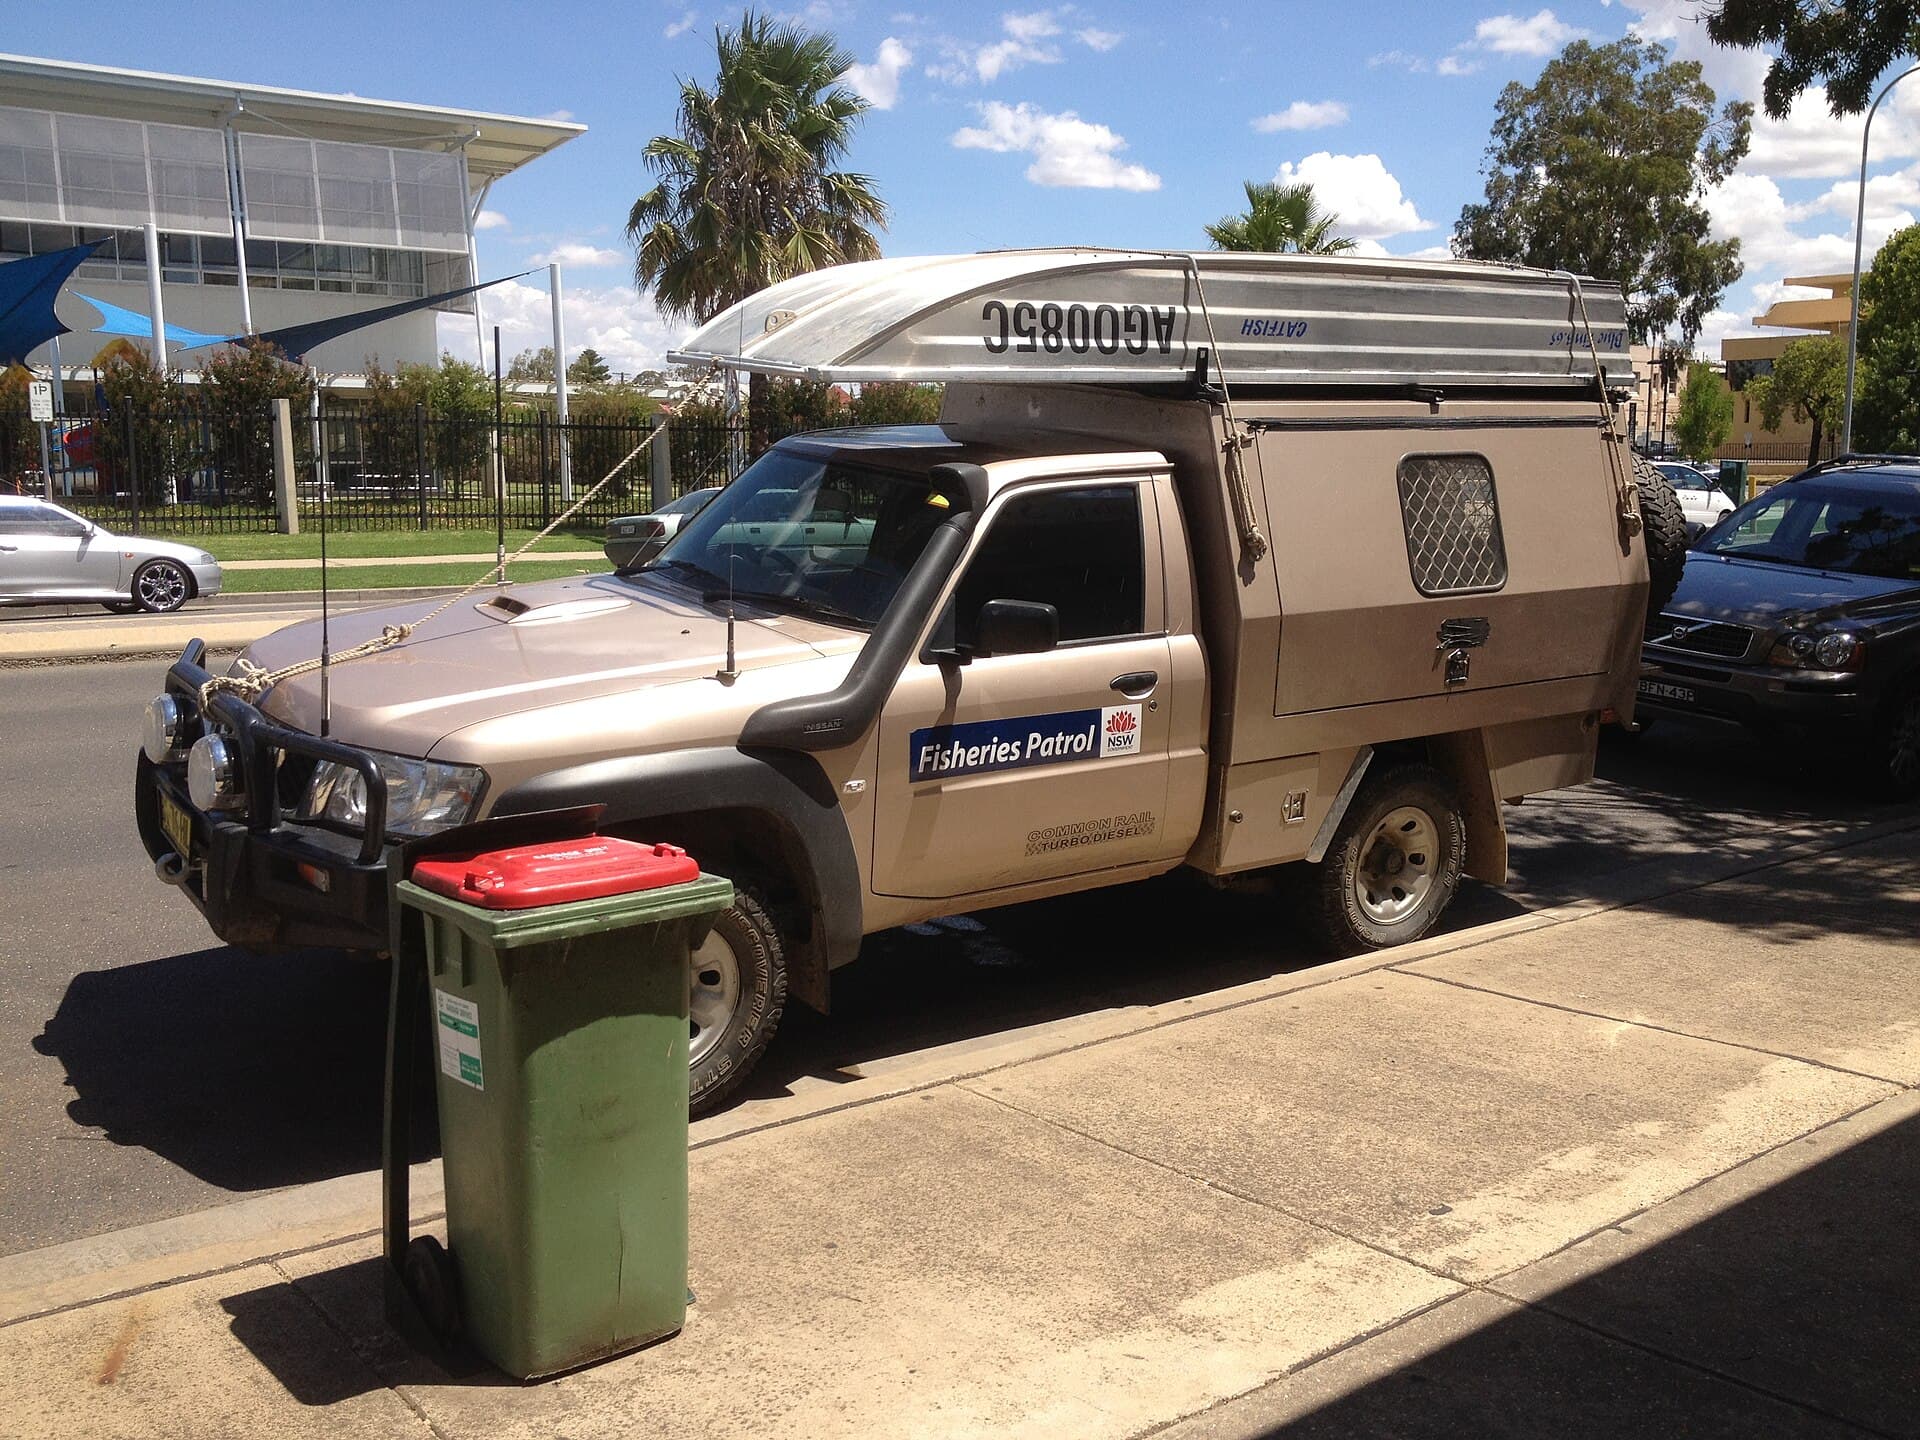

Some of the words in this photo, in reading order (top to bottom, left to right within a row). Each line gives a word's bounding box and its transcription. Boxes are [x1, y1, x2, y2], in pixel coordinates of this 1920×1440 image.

[1241, 318, 1308, 338] CATFISH
[1597, 332, 1623, 349] Blue
[33, 383, 47, 395] 1P
[918, 736, 1022, 773] Fisheries
[1025, 725, 1096, 759] Patrol
[1107, 734, 1135, 748] NSW
[1027, 817, 1111, 842] COMMON
[1114, 811, 1154, 828] RAIL
[1041, 836, 1090, 852] TURBO
[1093, 827, 1140, 843] DIESEL
